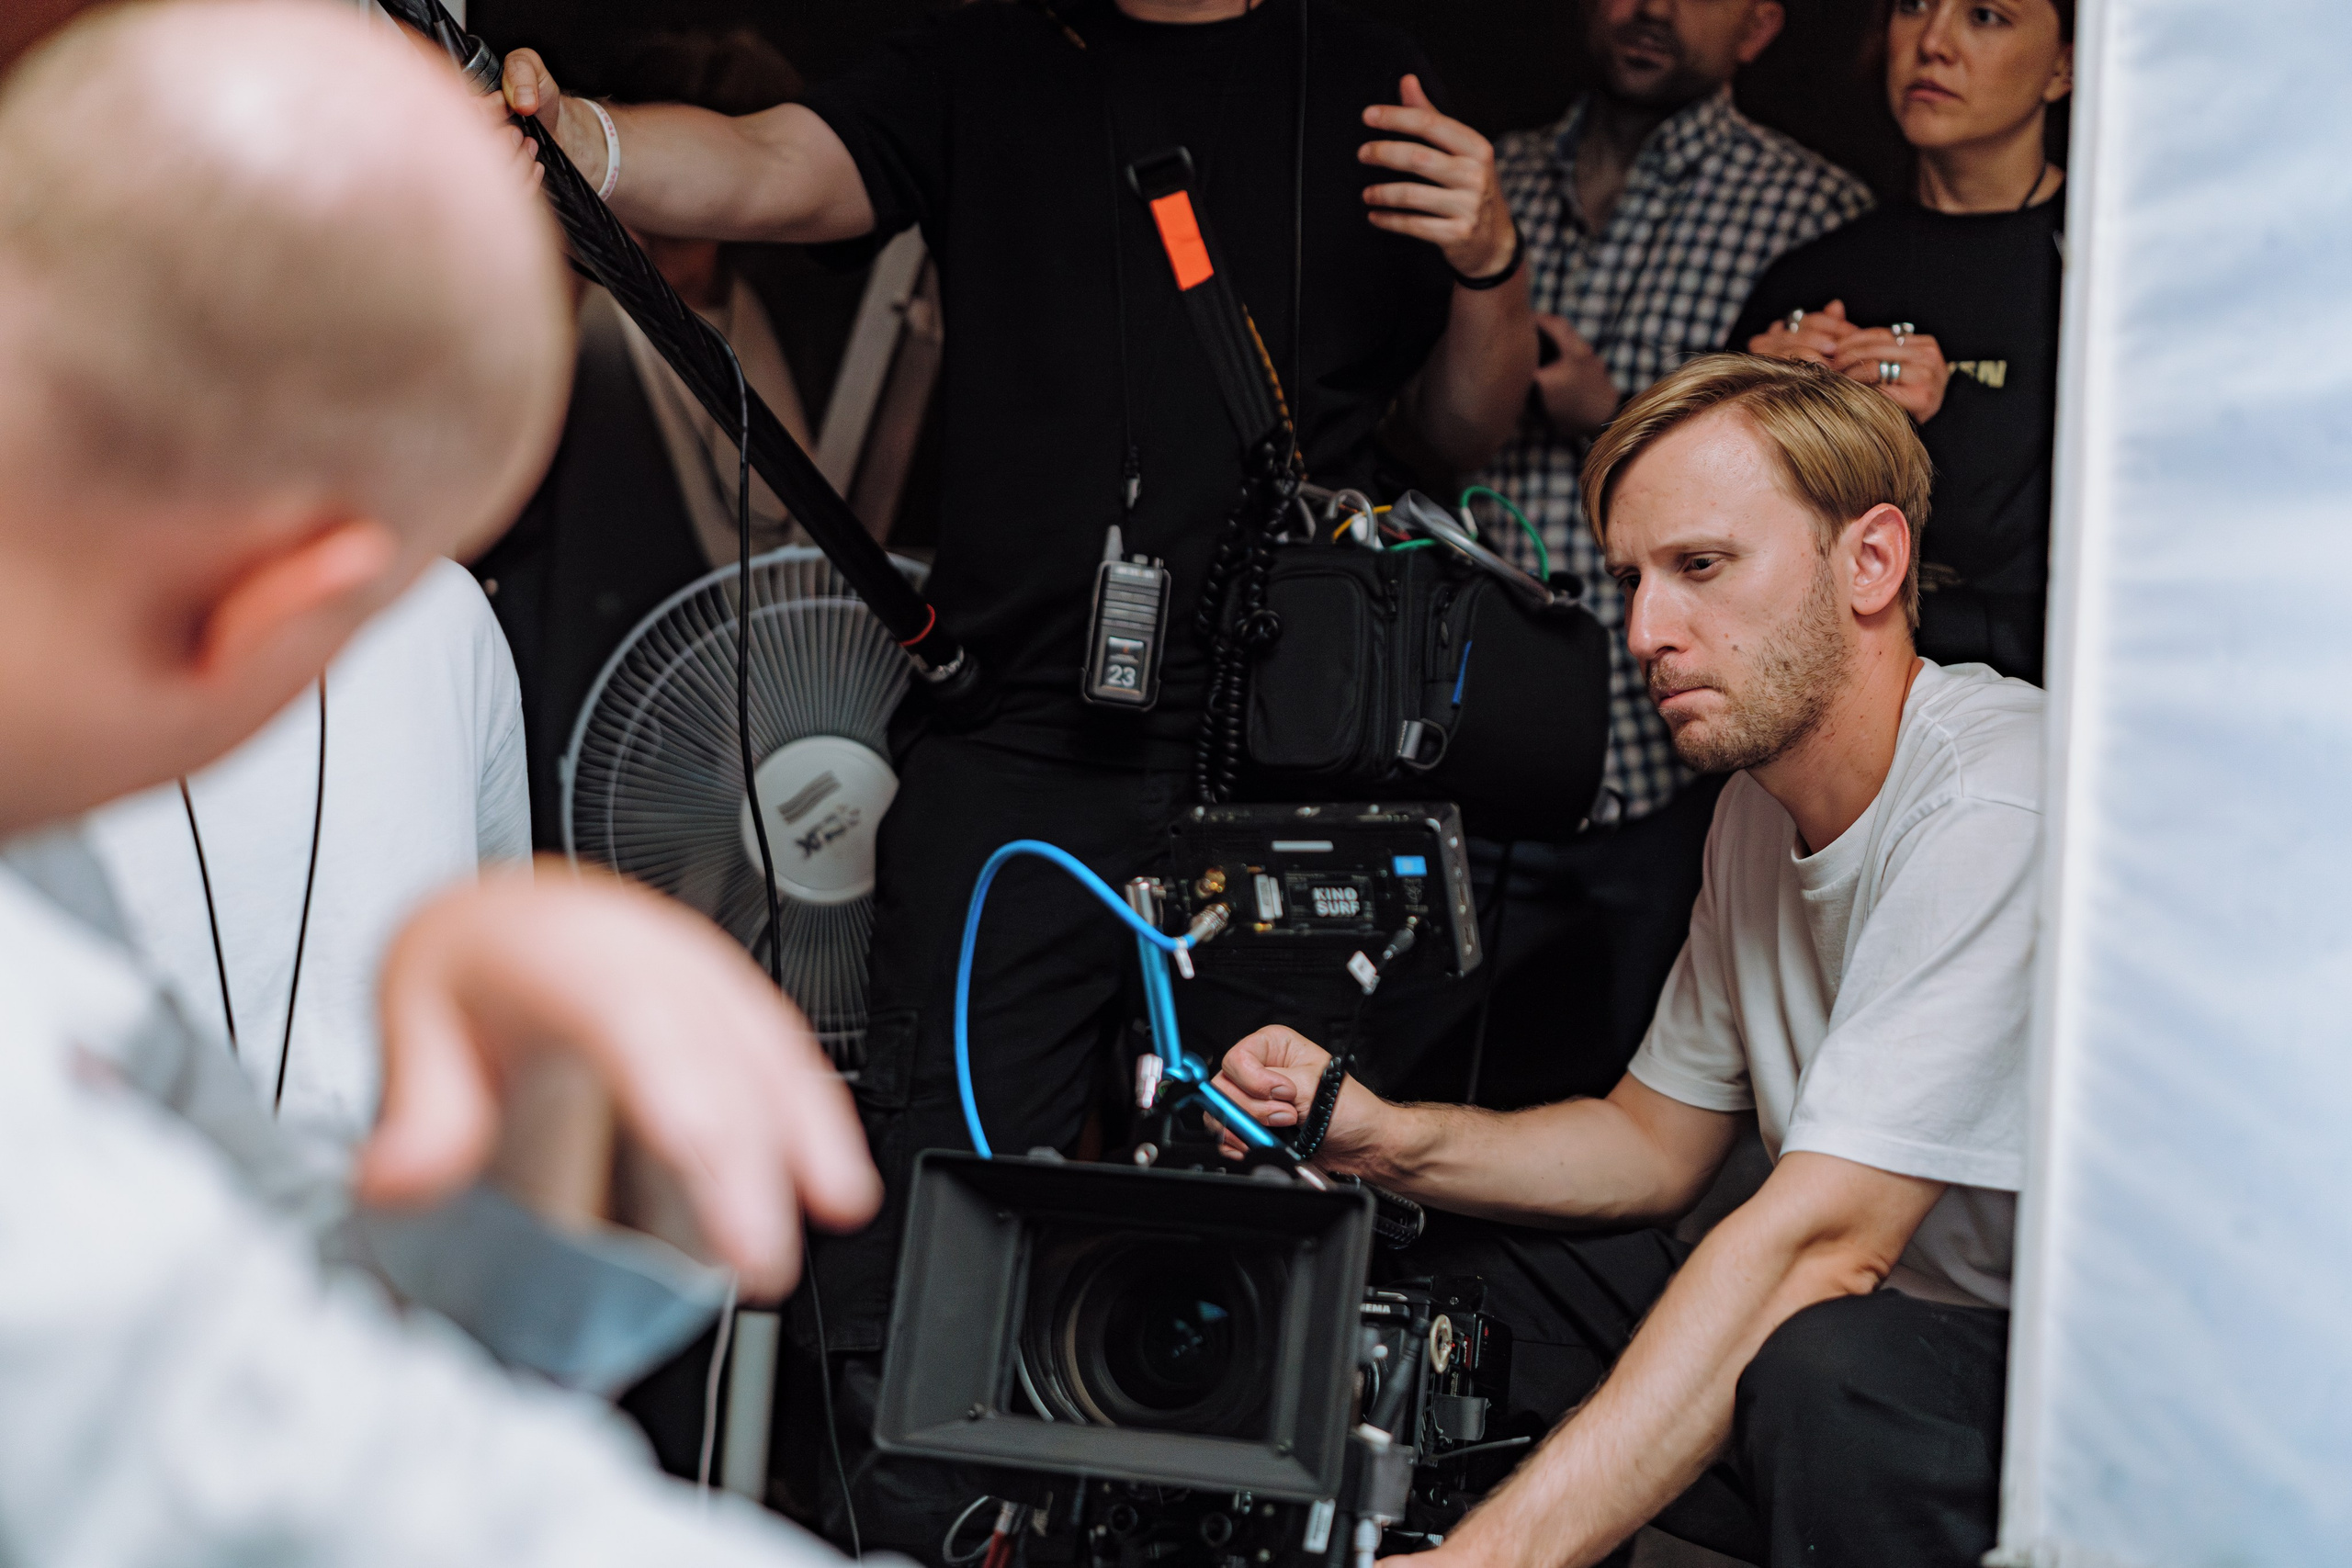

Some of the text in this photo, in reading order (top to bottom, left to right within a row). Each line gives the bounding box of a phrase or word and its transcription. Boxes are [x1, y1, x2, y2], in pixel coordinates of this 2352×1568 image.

[1107, 664, 1136, 688] 23
[1312, 886, 1358, 900] KINO
[1315, 900, 1360, 917] SURF
